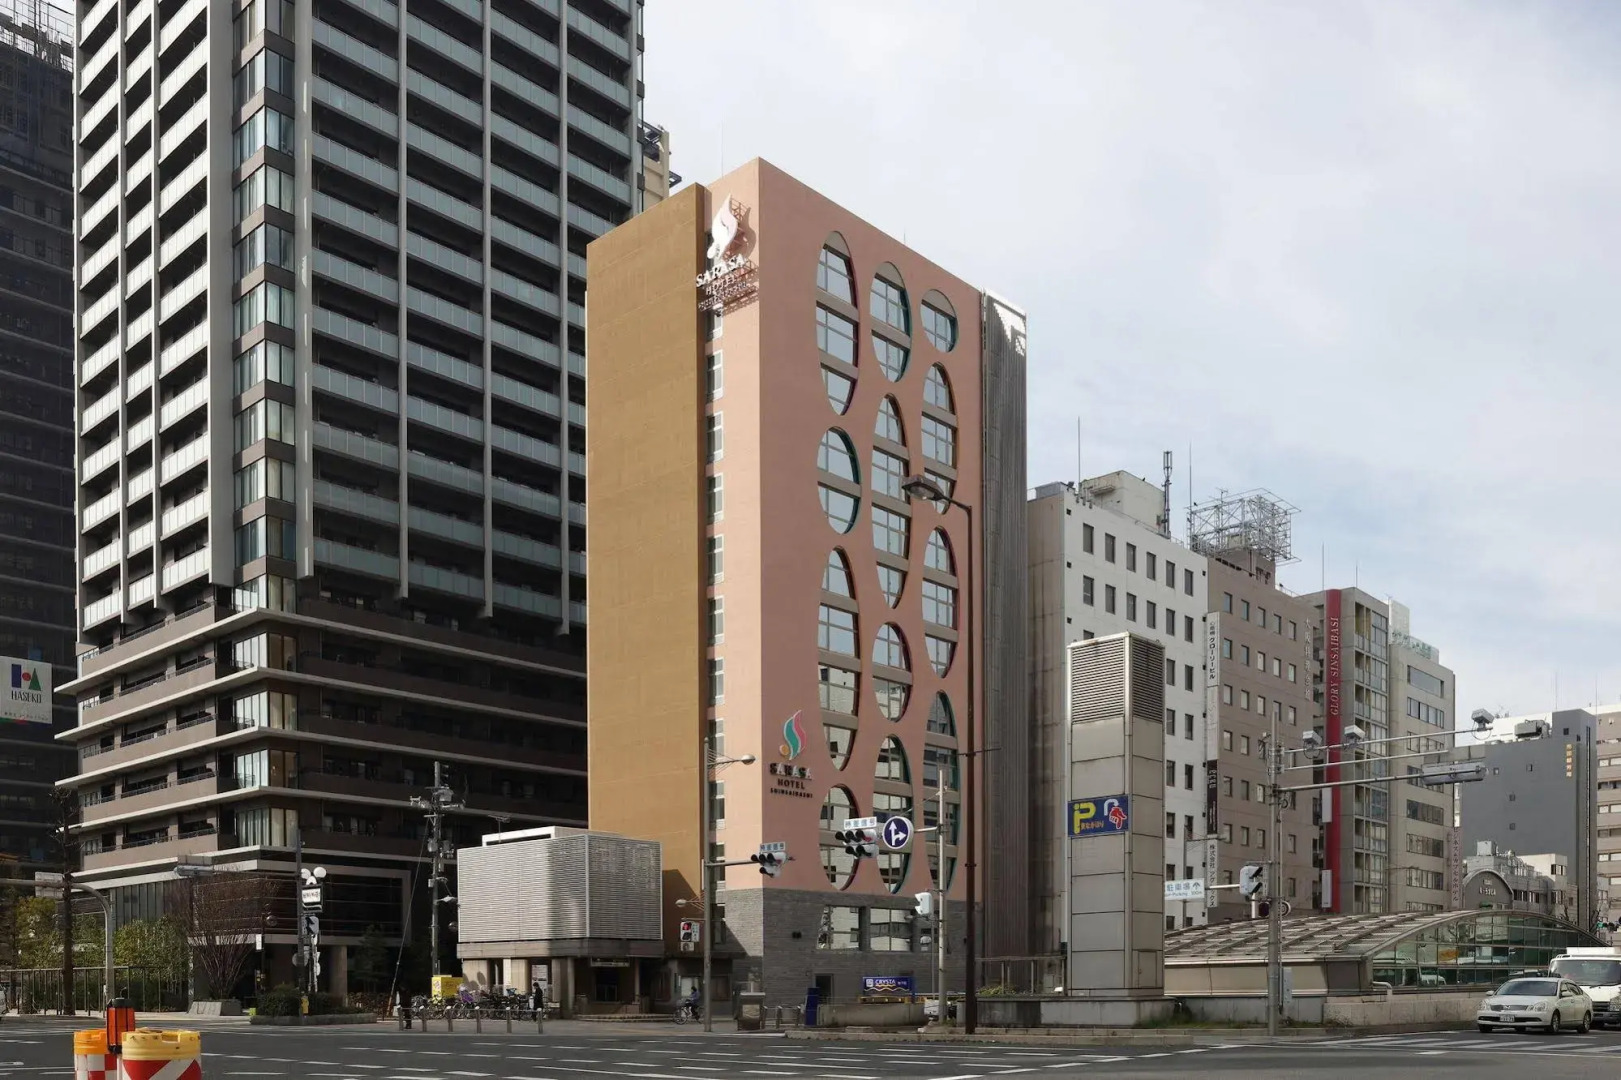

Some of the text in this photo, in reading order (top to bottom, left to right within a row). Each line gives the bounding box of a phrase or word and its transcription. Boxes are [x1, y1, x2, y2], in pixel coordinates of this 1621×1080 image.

[696, 253, 746, 287] SARASA
[1331, 617, 1339, 716] GLORY SINSAIBASI
[11, 690, 42, 704] HASEKO
[769, 763, 812, 780] SARASA
[777, 778, 805, 790] HOTEL
